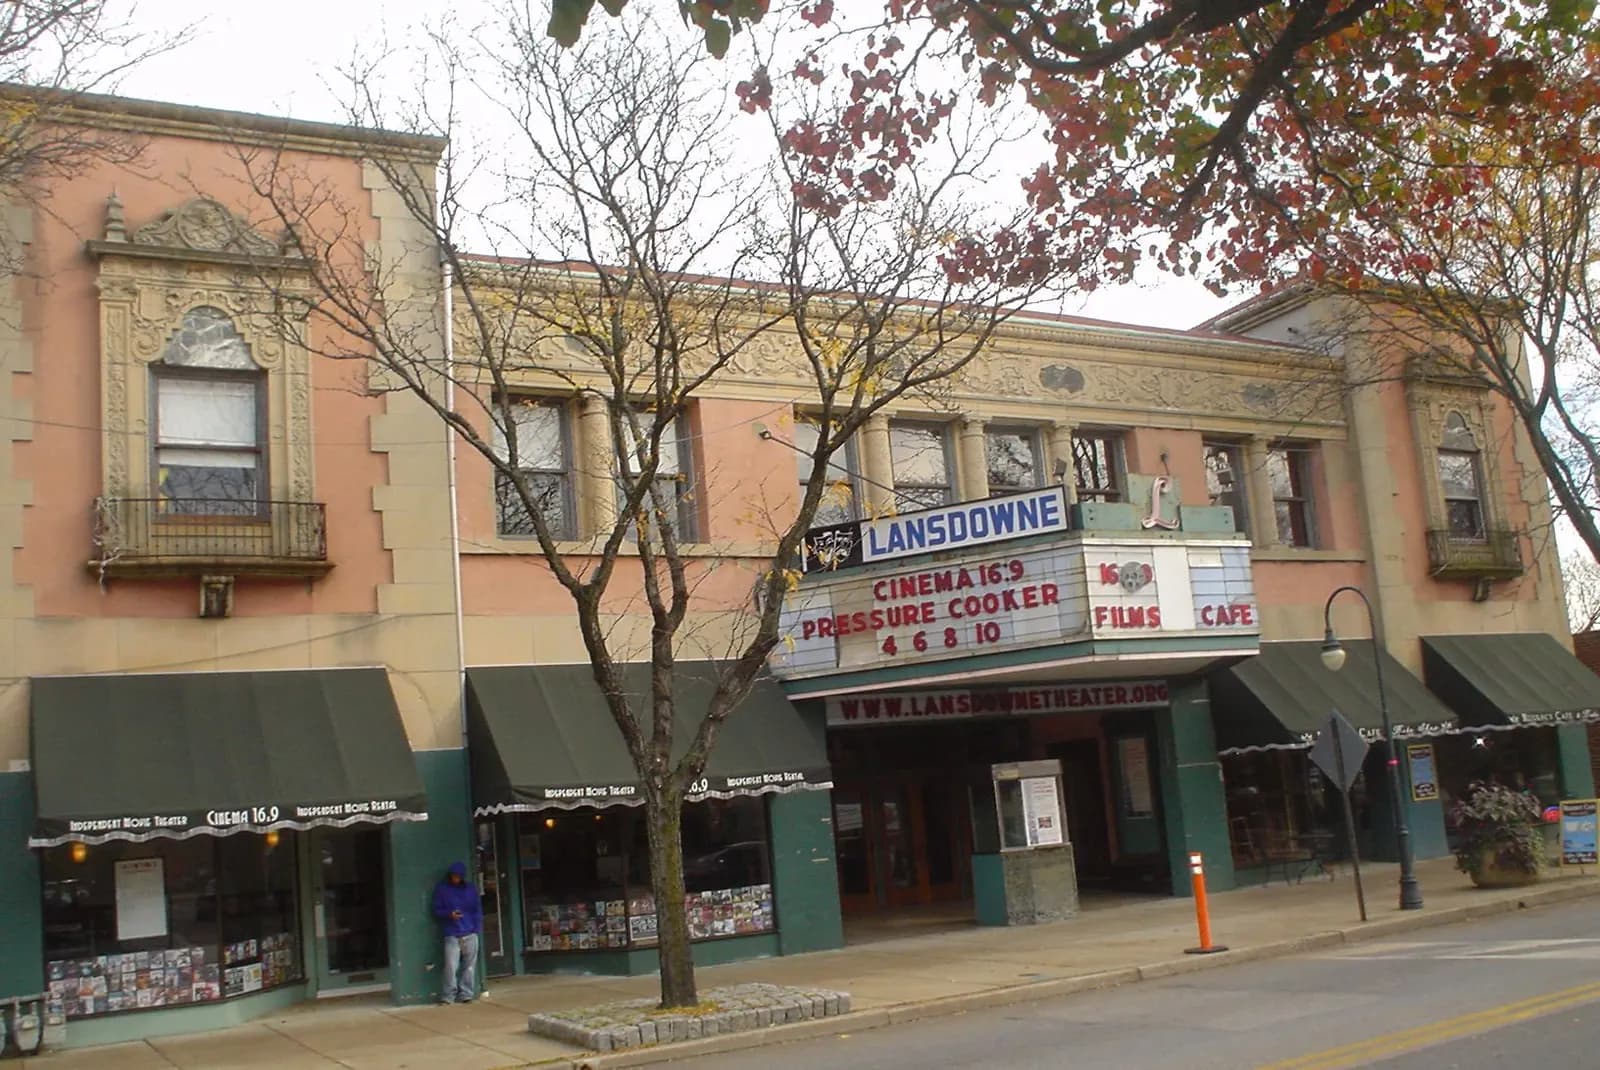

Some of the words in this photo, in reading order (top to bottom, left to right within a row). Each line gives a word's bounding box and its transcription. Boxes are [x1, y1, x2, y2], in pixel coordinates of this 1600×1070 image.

[869, 494, 1060, 556] LANSDOWNE
[873, 567, 974, 601] CINEMA
[979, 559, 1025, 587] 16:9
[802, 601, 936, 641] PRESSURE
[948, 583, 1060, 620] COOKER
[1094, 605, 1161, 629] FILMS
[1201, 604, 1254, 627] CAFE
[881, 634, 898, 657] 4
[912, 630, 929, 652] 6
[943, 626, 958, 649] 8
[975, 621, 1001, 645] 10
[840, 684, 1169, 721] WWW.LANSDOWNETHEATER.ORG
[585, 786, 607, 797] MOVIE
[688, 778, 709, 793] 6.9
[207, 809, 249, 826] CINEMA
[252, 806, 279, 823] 16.9
[297, 803, 343, 817] INDEPENDENT
[344, 801, 369, 813] MOVIE
[70, 817, 121, 831] INDEPENDENT
[123, 816, 151, 829] MOVIE
[154, 815, 188, 827] THEATER
